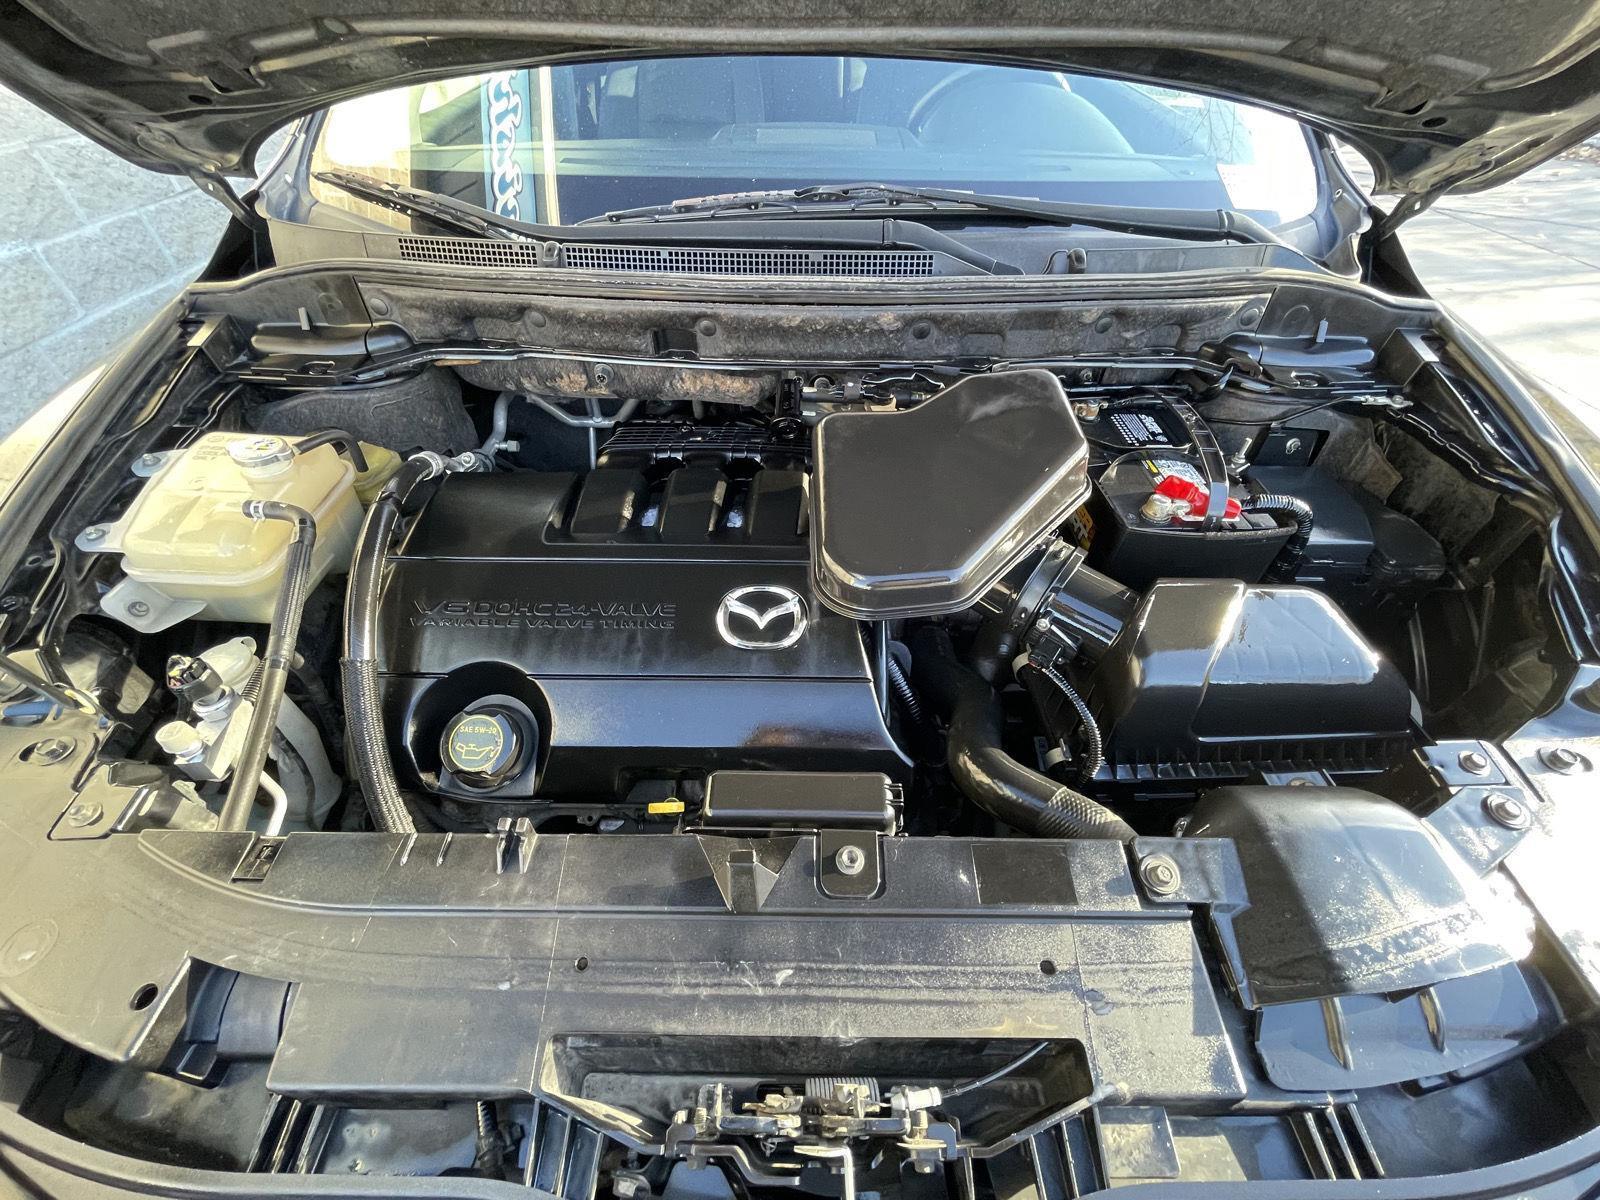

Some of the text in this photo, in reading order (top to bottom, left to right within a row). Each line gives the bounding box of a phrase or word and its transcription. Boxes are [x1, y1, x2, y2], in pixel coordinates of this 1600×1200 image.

[473, 599, 553, 617] DOHC
[554, 601, 677, 618] 24-VALVE
[409, 617, 676, 630] VARIABLE VALVE TIMING
[460, 724, 497, 734] SAE 5W-20
